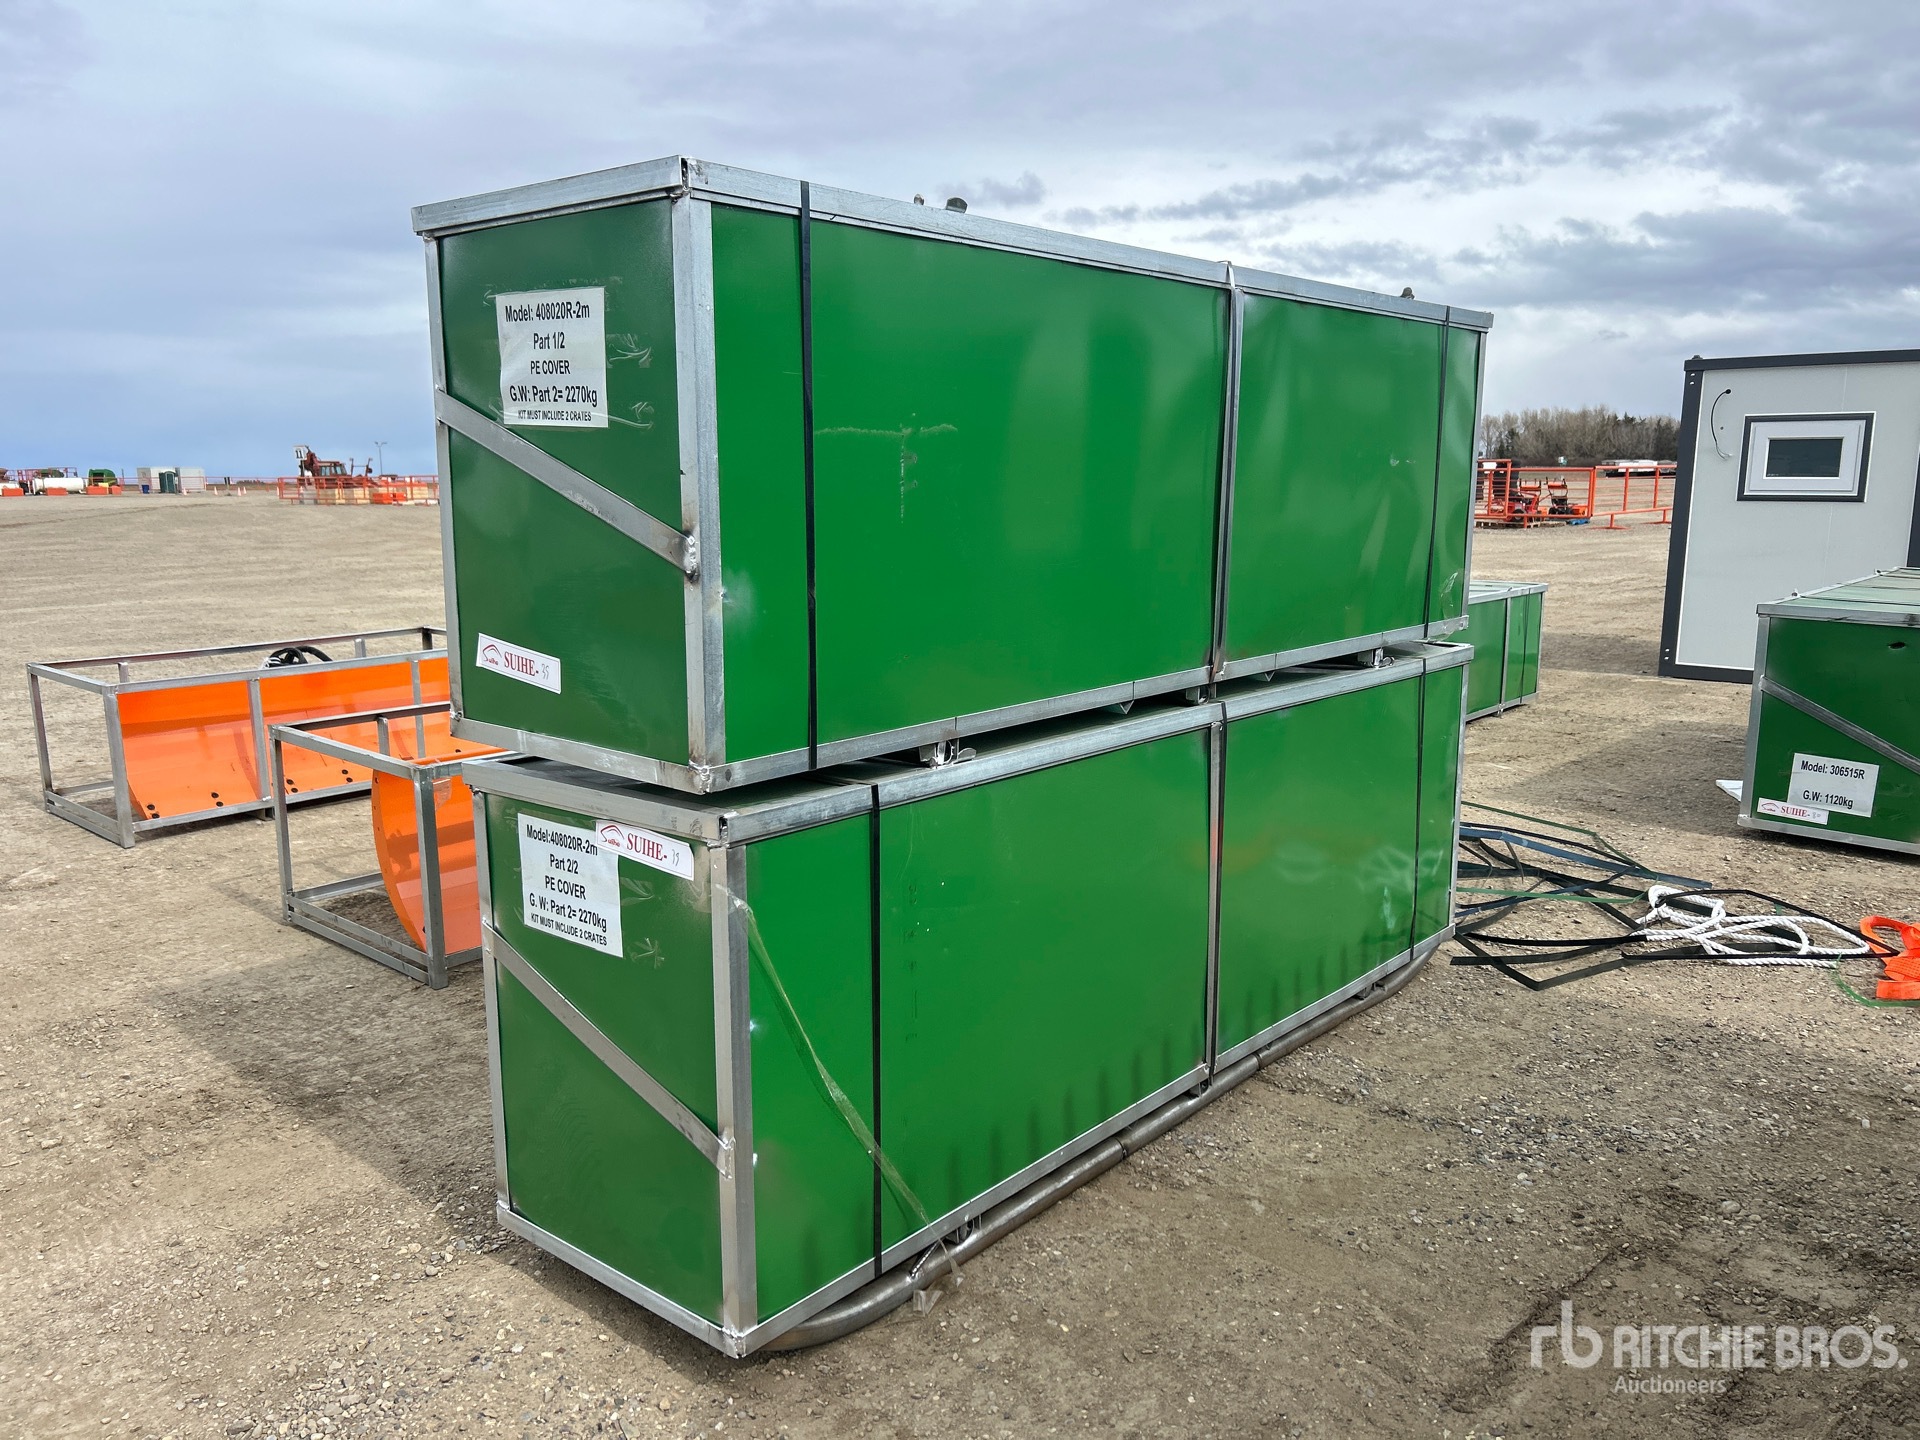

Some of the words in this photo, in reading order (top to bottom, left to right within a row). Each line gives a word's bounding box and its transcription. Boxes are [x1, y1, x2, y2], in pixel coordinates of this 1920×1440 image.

[505, 304, 534, 322] Model:
[535, 301, 590, 320] 408020R-2m
[533, 333, 550, 350] Part
[553, 332, 565, 349] 1/2
[530, 361, 541, 375] PE
[542, 360, 571, 375] COVER
[509, 385, 531, 402] G.W:
[532, 386, 550, 403] Part
[552, 386, 563, 403] 2=
[565, 386, 597, 407] 2270kg
[518, 410, 526, 419] KIT
[527, 410, 541, 420] MUST
[542, 411, 565, 421] INCLUDE
[565, 411, 569, 420] 2
[569, 411, 592, 422] CRATES
[1801, 760, 1828, 774] Model:
[1830, 764, 1865, 780] 306515R
[1803, 789, 1822, 803] G.W:
[1824, 794, 1854, 810] 1120kg
[550, 854, 566, 871] Part
[567, 858, 579, 875] 2/2
[545, 875, 556, 892] PE
[557, 878, 587, 900] COVER
[550, 900, 566, 918] Part
[567, 905, 577, 919] 2=
[578, 908, 607, 933] 2270kg
[531, 913, 539, 923] KIT
[539, 915, 555, 928] MUST
[555, 919, 579, 937] INCLUDE
[579, 928, 583, 939] 2
[584, 931, 607, 946] CRATES
